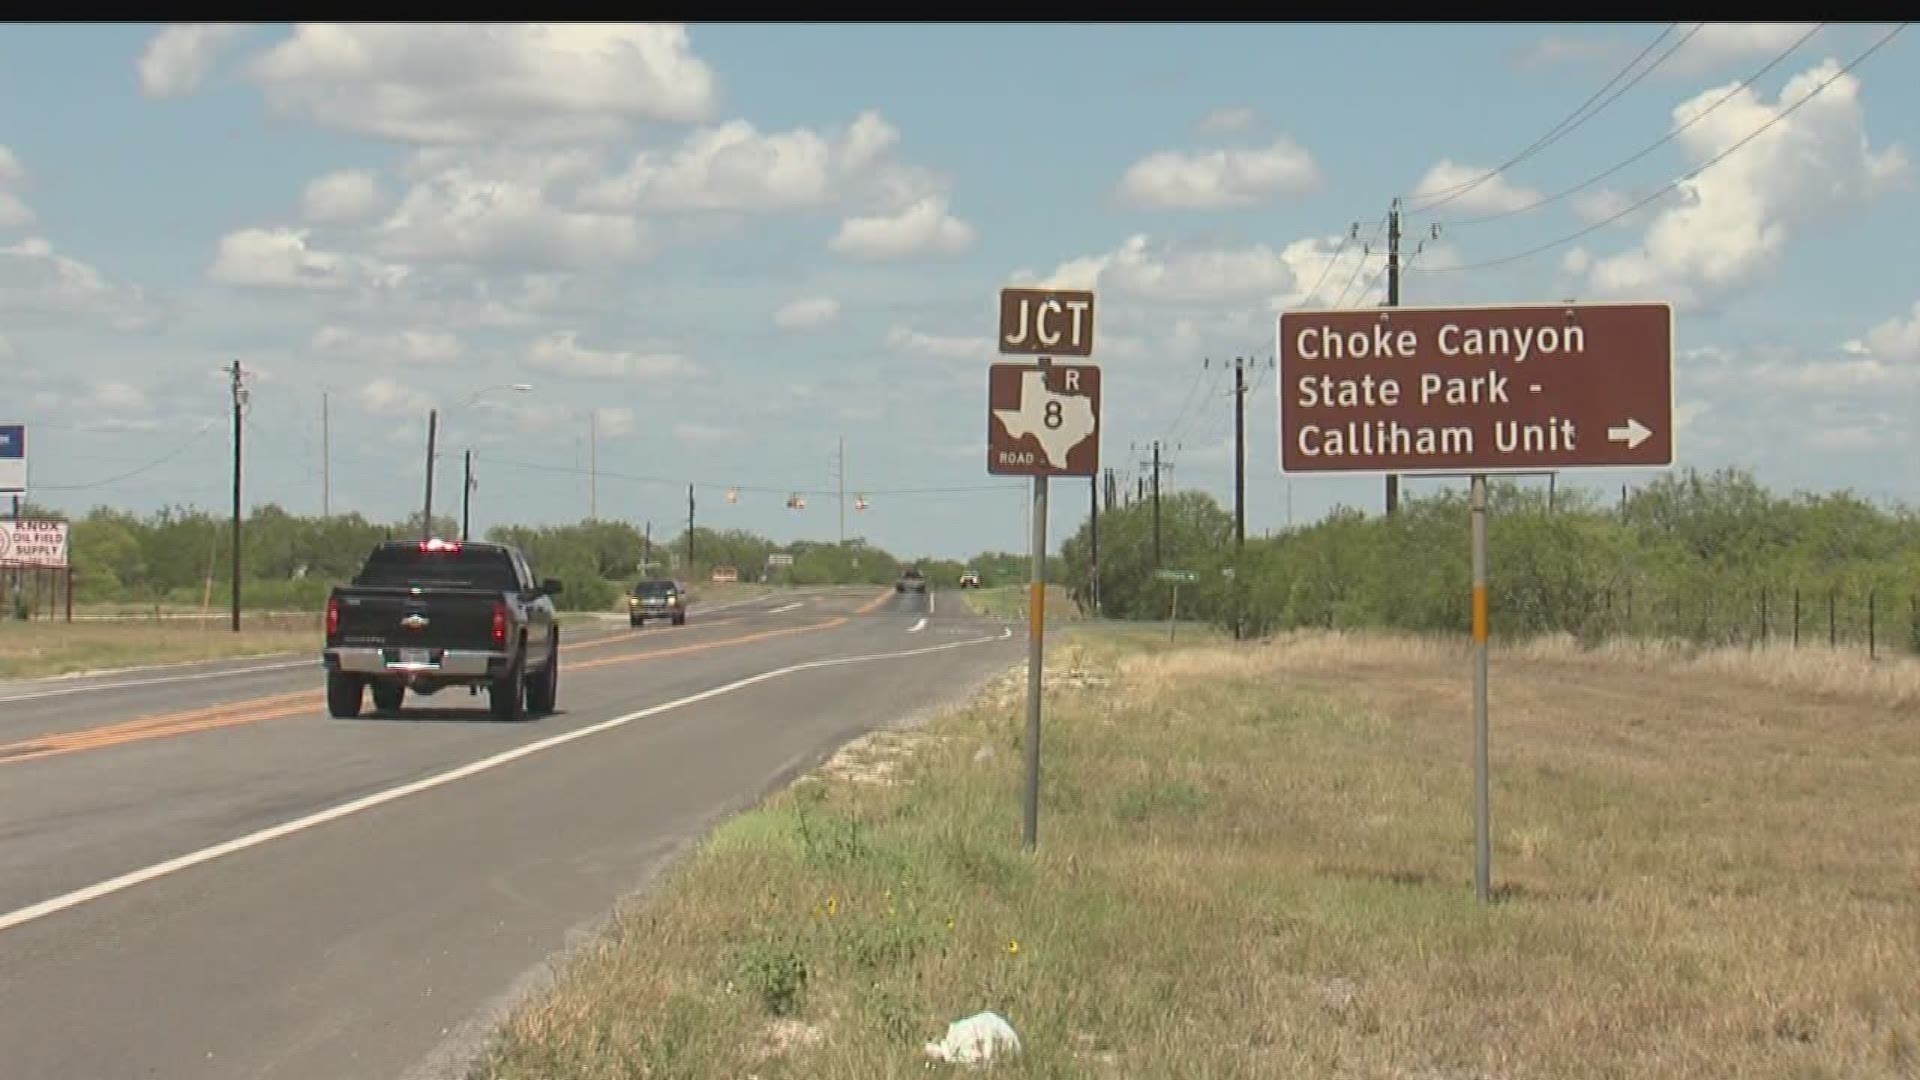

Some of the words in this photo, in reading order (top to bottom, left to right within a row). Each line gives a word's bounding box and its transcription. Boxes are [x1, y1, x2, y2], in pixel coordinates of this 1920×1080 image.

[1006, 300, 1088, 345] JCT
[1297, 325, 1417, 360] Choke
[1438, 323, 1585, 362] Canyon
[1065, 370, 1080, 391] R
[1298, 372, 1401, 408] State
[1420, 370, 1510, 406] Park
[1529, 384, 1542, 393] -
[1044, 401, 1063, 430] 8
[1297, 420, 1474, 456] Calliham
[1494, 417, 1577, 454] Unit
[999, 451, 1034, 464] ROAD
[13, 533, 31, 543] OIL
[35, 533, 63, 543] FIELD
[15, 521, 59, 531] KNOX
[16, 545, 58, 555] SUPPLY
